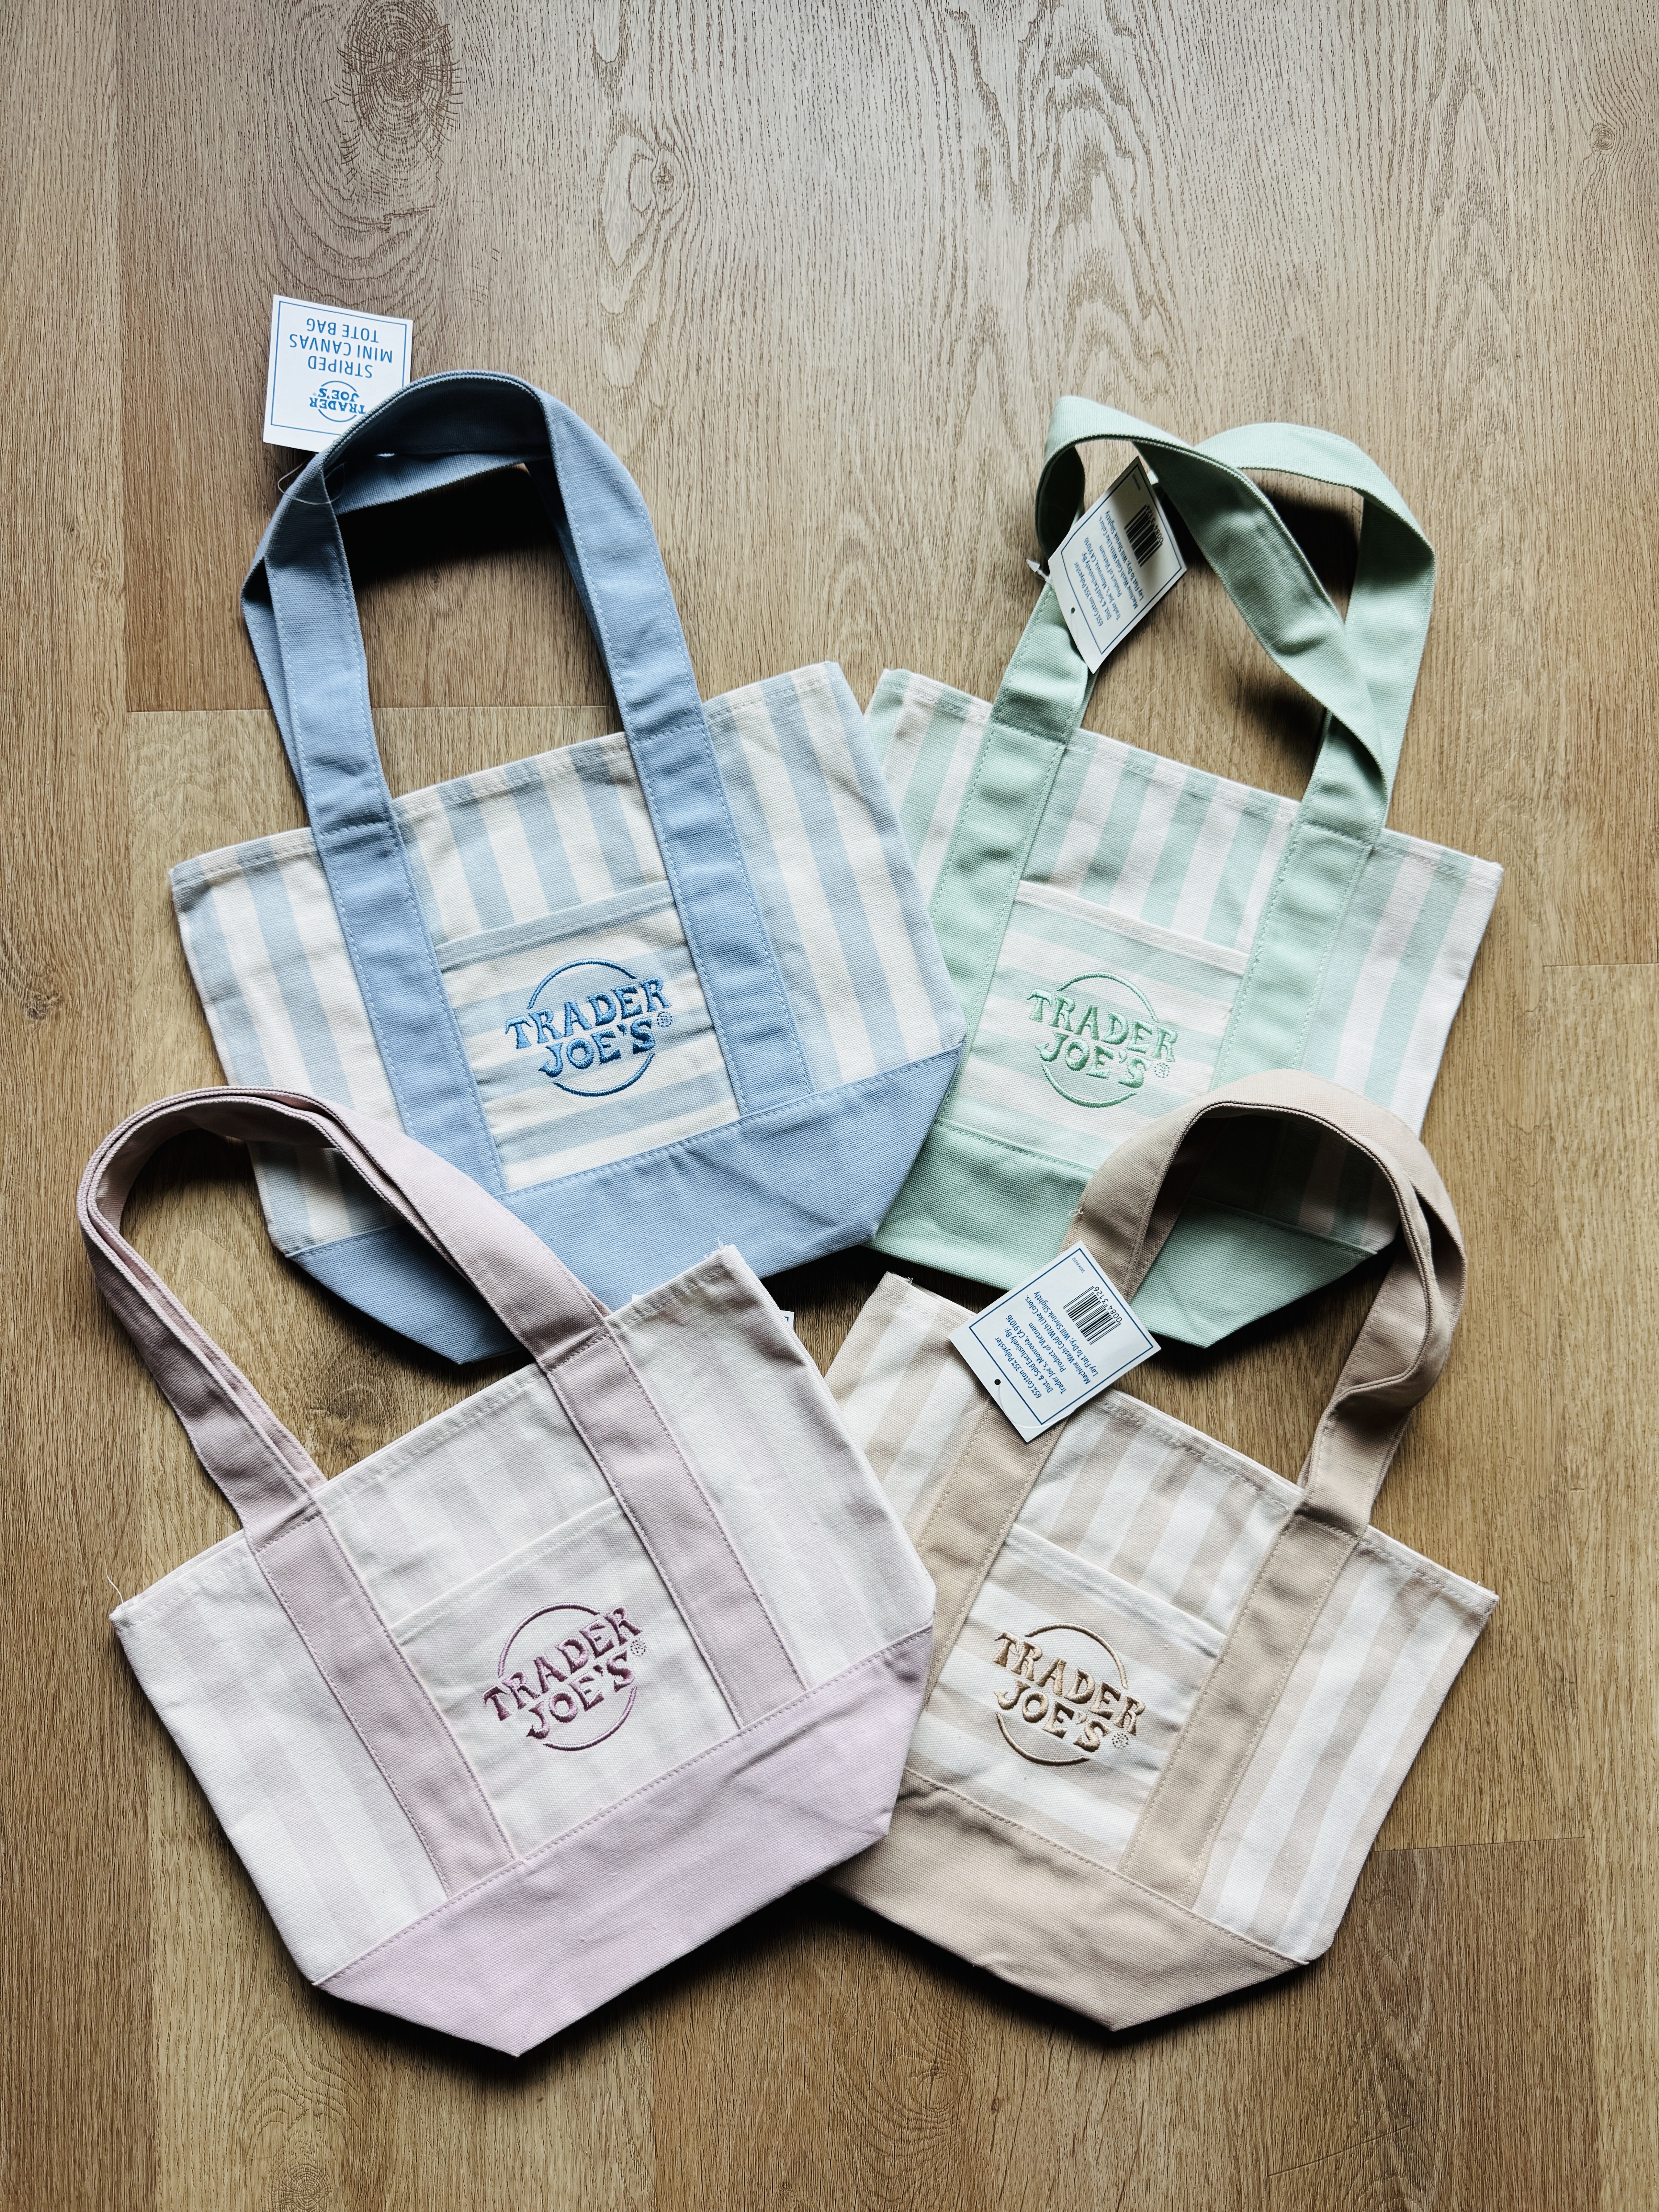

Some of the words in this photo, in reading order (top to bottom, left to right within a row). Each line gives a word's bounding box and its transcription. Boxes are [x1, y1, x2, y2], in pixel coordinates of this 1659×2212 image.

[306, 318, 337, 335] BAG
[342, 324, 379, 343] TOTE
[289, 334, 351, 356] CANVAS
[357, 345, 393, 363] MINI
[308, 356, 373, 378] STRIPED
[318, 388, 360, 402] JOE'S
[309, 397, 366, 415] TRADER
[1105, 510, 1116, 534] Slightly
[1084, 537, 1094, 555] 91016
[1113, 531, 1124, 553] Shrink
[1090, 552, 1097, 563] CA
[1099, 544, 1110, 570] Vietnam
[1110, 545, 1118, 562] With
[1115, 558, 1123, 573] Cold
[1074, 562, 1087, 589] Polyester
[1085, 560, 1099, 591] Exclusively
[1120, 570, 1129, 588] Wash
[1130, 572, 1135, 581] To
[1132, 578, 1140, 592] Flat
[1111, 574, 1123, 598] Product
[1096, 589, 1104, 603] Sold
[1127, 585, 1139, 610] Machine
[1089, 596, 1099, 617] Cotton
[1111, 602, 1121, 621] Trader
[1096, 614, 1104, 627] 65%
[505, 977, 672, 1049] TRADER
[1026, 988, 1178, 1062] TRADER
[538, 1017, 656, 1077] JOE'S
[1035, 1030, 1152, 1089] JOE'S
[1025, 1295, 1039, 1314] Colors.
[1034, 1291, 1051, 1313] Slightly
[1006, 1315, 1020, 1331] 91016
[1037, 1312, 1047, 1325] Like
[1048, 1311, 1063, 1330] Shrink
[1004, 1328, 1012, 1338] By:
[1017, 1329, 1025, 1338] CA
[1029, 1322, 1046, 1346] Vietnam
[1044, 1323, 1056, 1338] With
[1059, 1328, 1071, 1341] Will
[994, 1337, 1015, 1362] Polyester
[1010, 1336, 1032, 1365] Exclusively
[1024, 1336, 1044, 1364] Monrovia,
[1052, 1336, 1065, 1349] Cold
[1069, 1338, 1079, 1351] Dry;
[1048, 1350, 1066, 1372] Product
[1062, 1347, 1075, 1364] Wash
[1077, 1349, 1083, 1358] To
[1080, 1355, 1092, 1368] Flat
[1011, 1360, 1022, 1372] 35%
[1029, 1363, 1041, 1376] Sold
[1043, 1361, 1056, 1377] Joe's,
[1073, 1361, 1091, 1384] Machine
[1089, 1366, 1098, 1377] Lay
[1020, 1370, 1034, 1389] Cotton
[1042, 1379, 1053, 1393] Dist.
[1052, 1376, 1066, 1395] Trader
[1030, 1387, 1042, 1398] 65%
[482, 1605, 642, 1721] TRADER
[993, 1629, 1146, 1736] TRADER
[526, 1649, 635, 1739] JOE'S
[994, 1678, 1112, 1753] JOE'S
